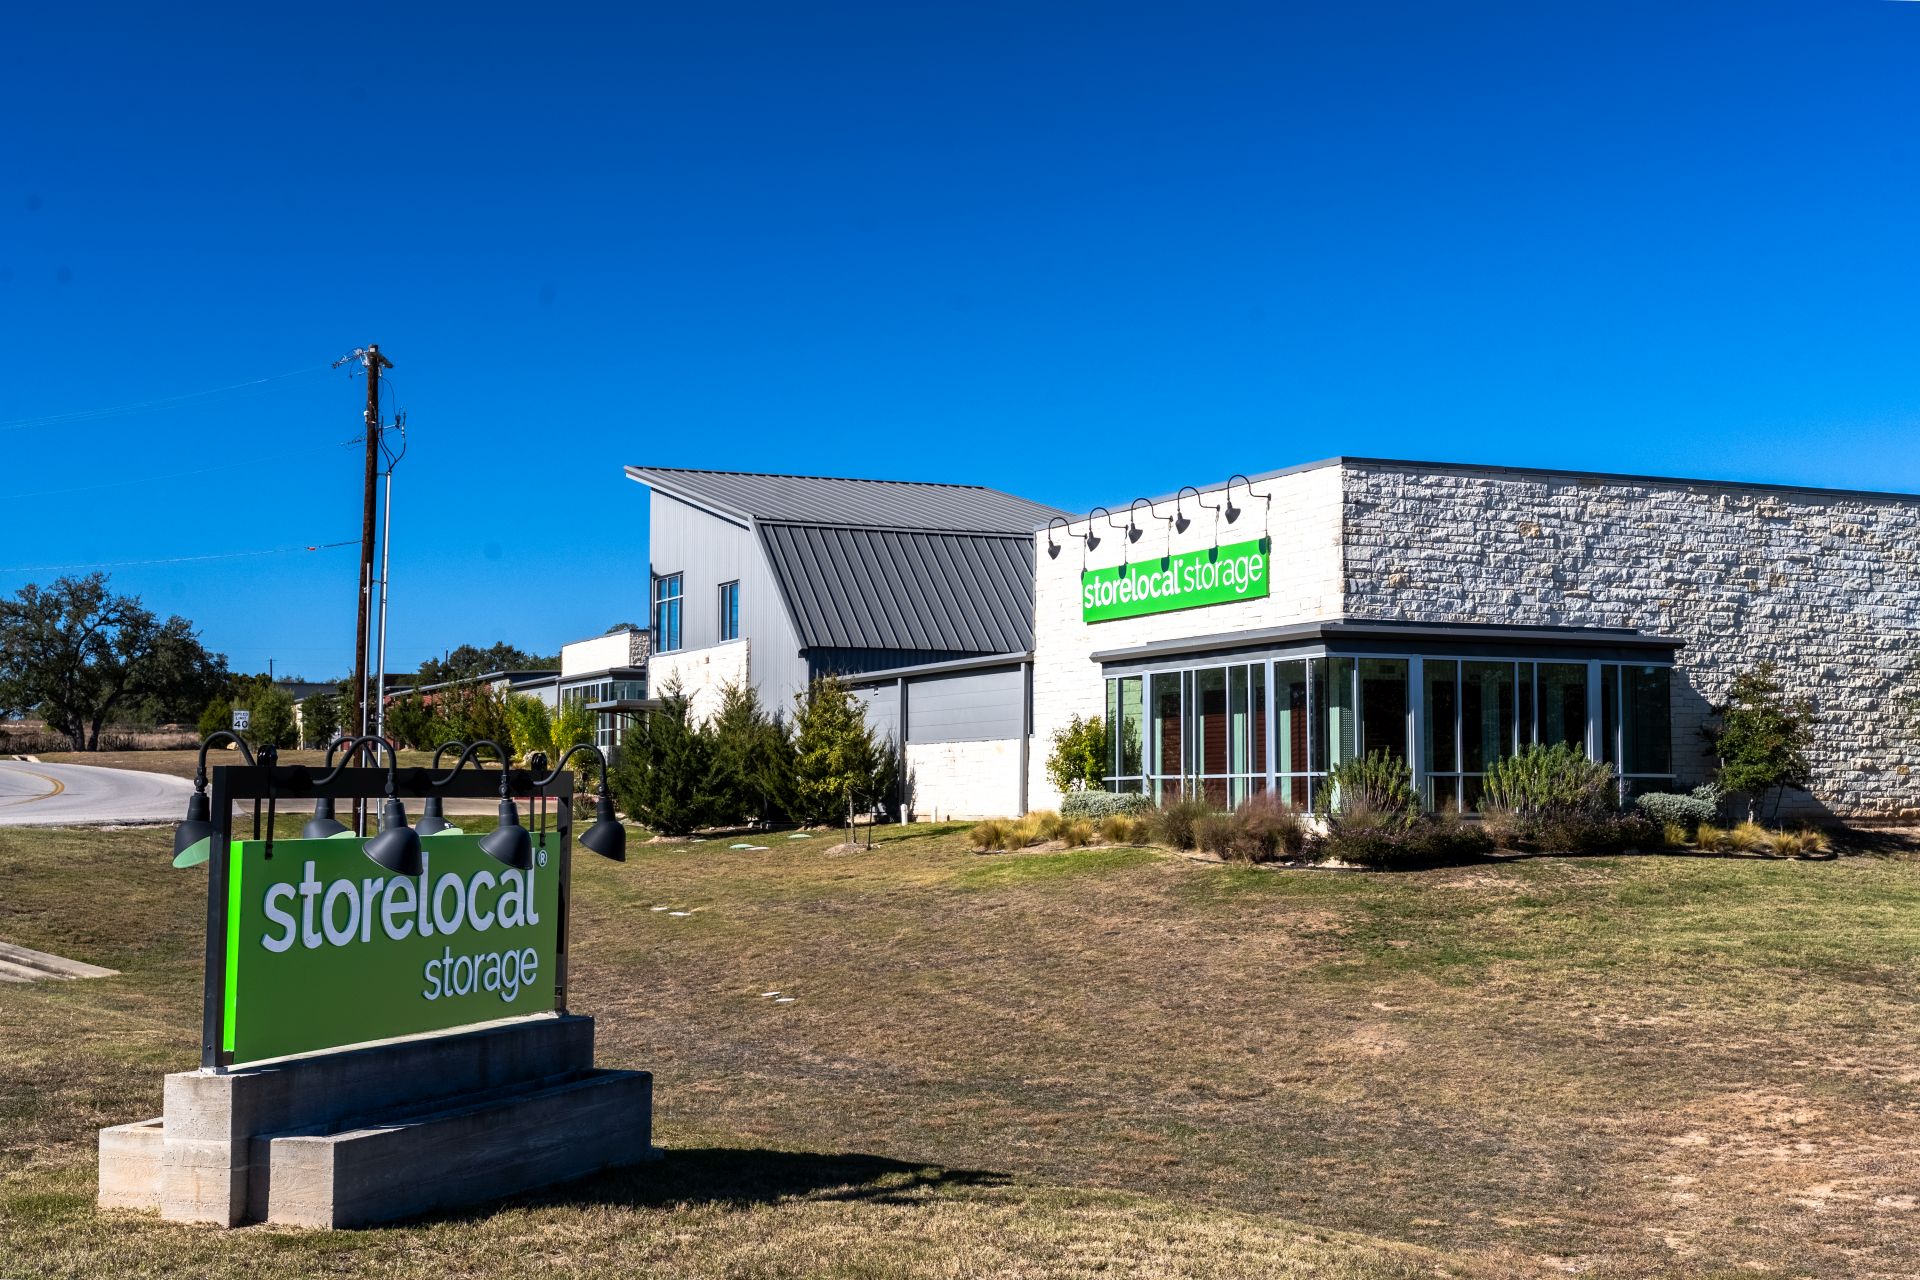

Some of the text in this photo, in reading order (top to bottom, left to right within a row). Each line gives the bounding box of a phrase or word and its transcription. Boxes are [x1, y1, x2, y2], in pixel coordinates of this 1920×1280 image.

[1084, 553, 1263, 609] storelocal storage
[234, 720, 248, 728] 40
[260, 849, 540, 953] storelocal
[422, 945, 539, 1002] storage
